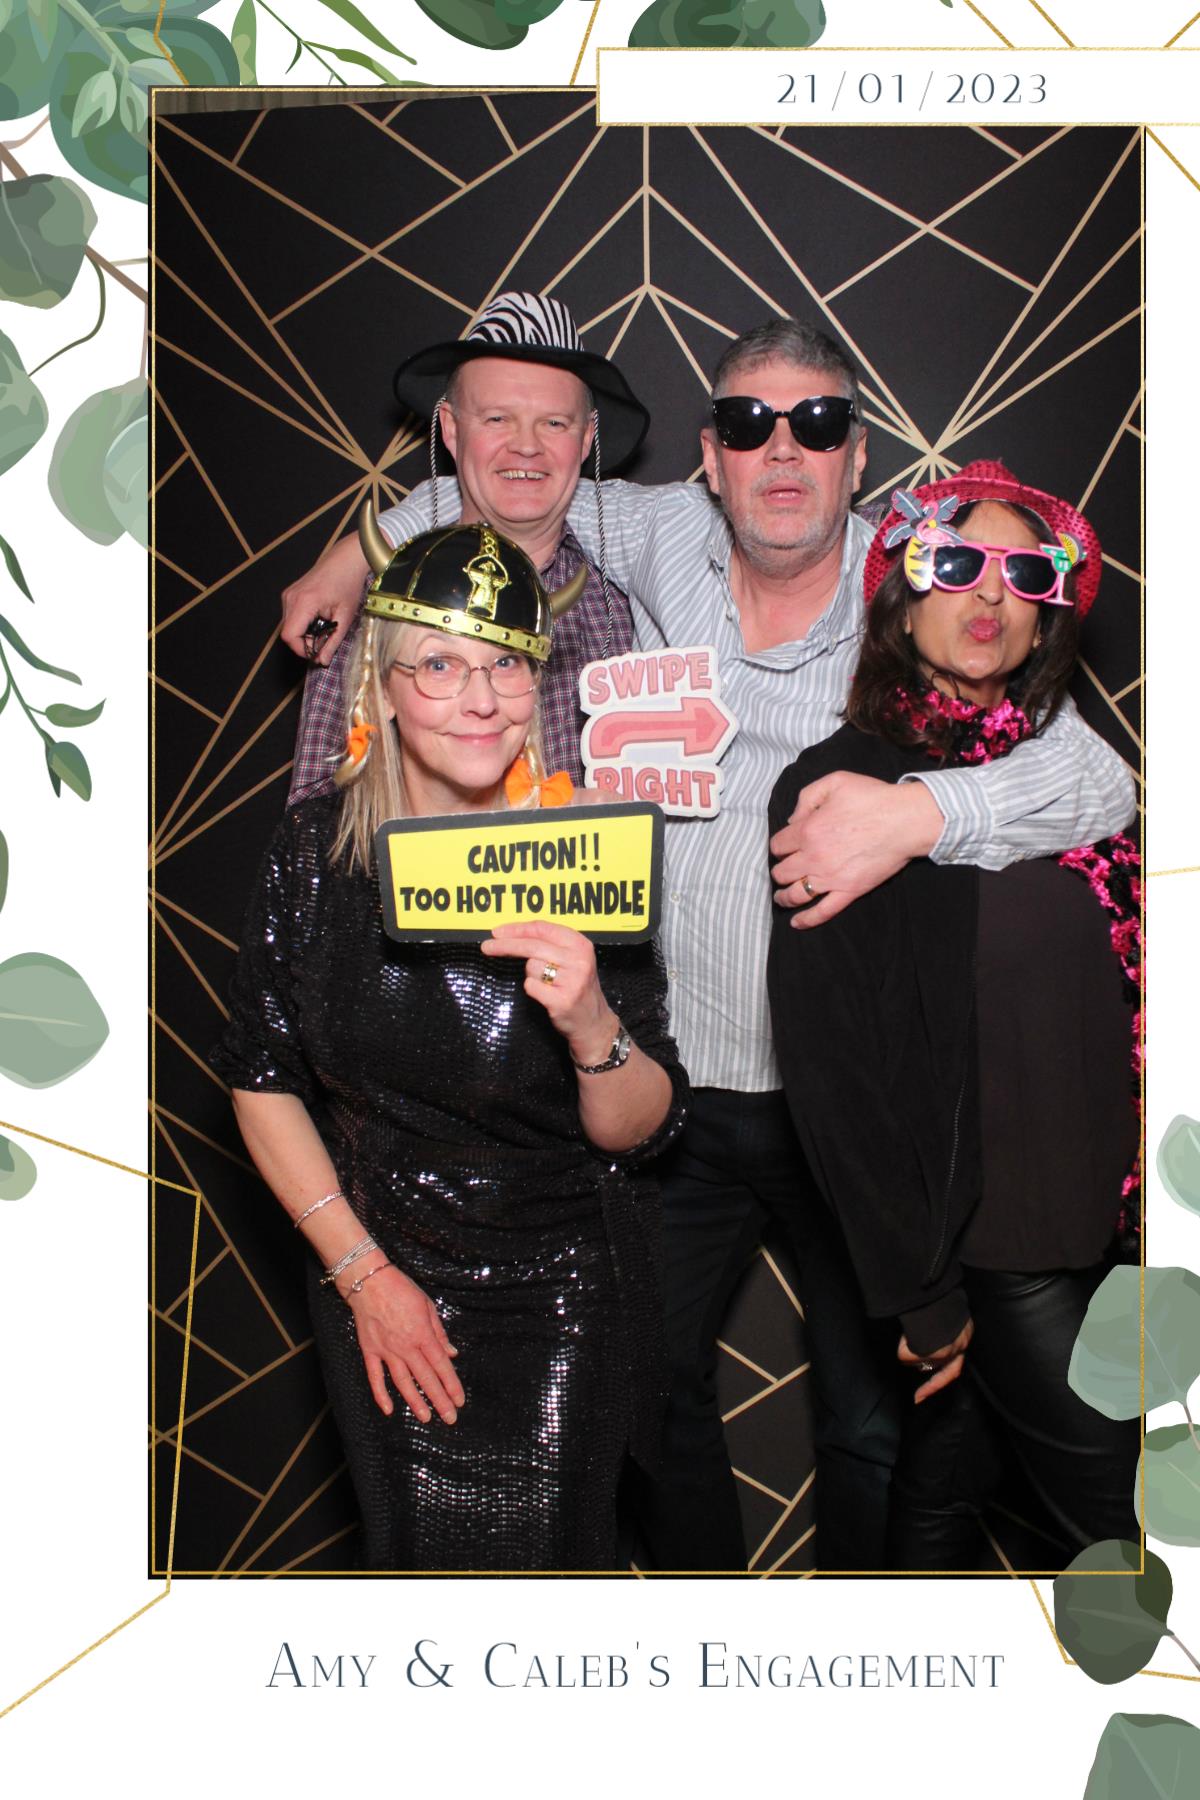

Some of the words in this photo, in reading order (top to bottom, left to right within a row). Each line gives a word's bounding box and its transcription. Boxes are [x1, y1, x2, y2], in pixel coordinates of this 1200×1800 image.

[587, 652, 712, 705] SWIPE
[593, 766, 716, 808] RIGHT
[467, 832, 601, 874] CAUTION!!
[400, 887, 449, 912] TOO
[456, 884, 506, 913] HOT
[511, 883, 544, 913] TO
[550, 880, 645, 916] HANDLE
